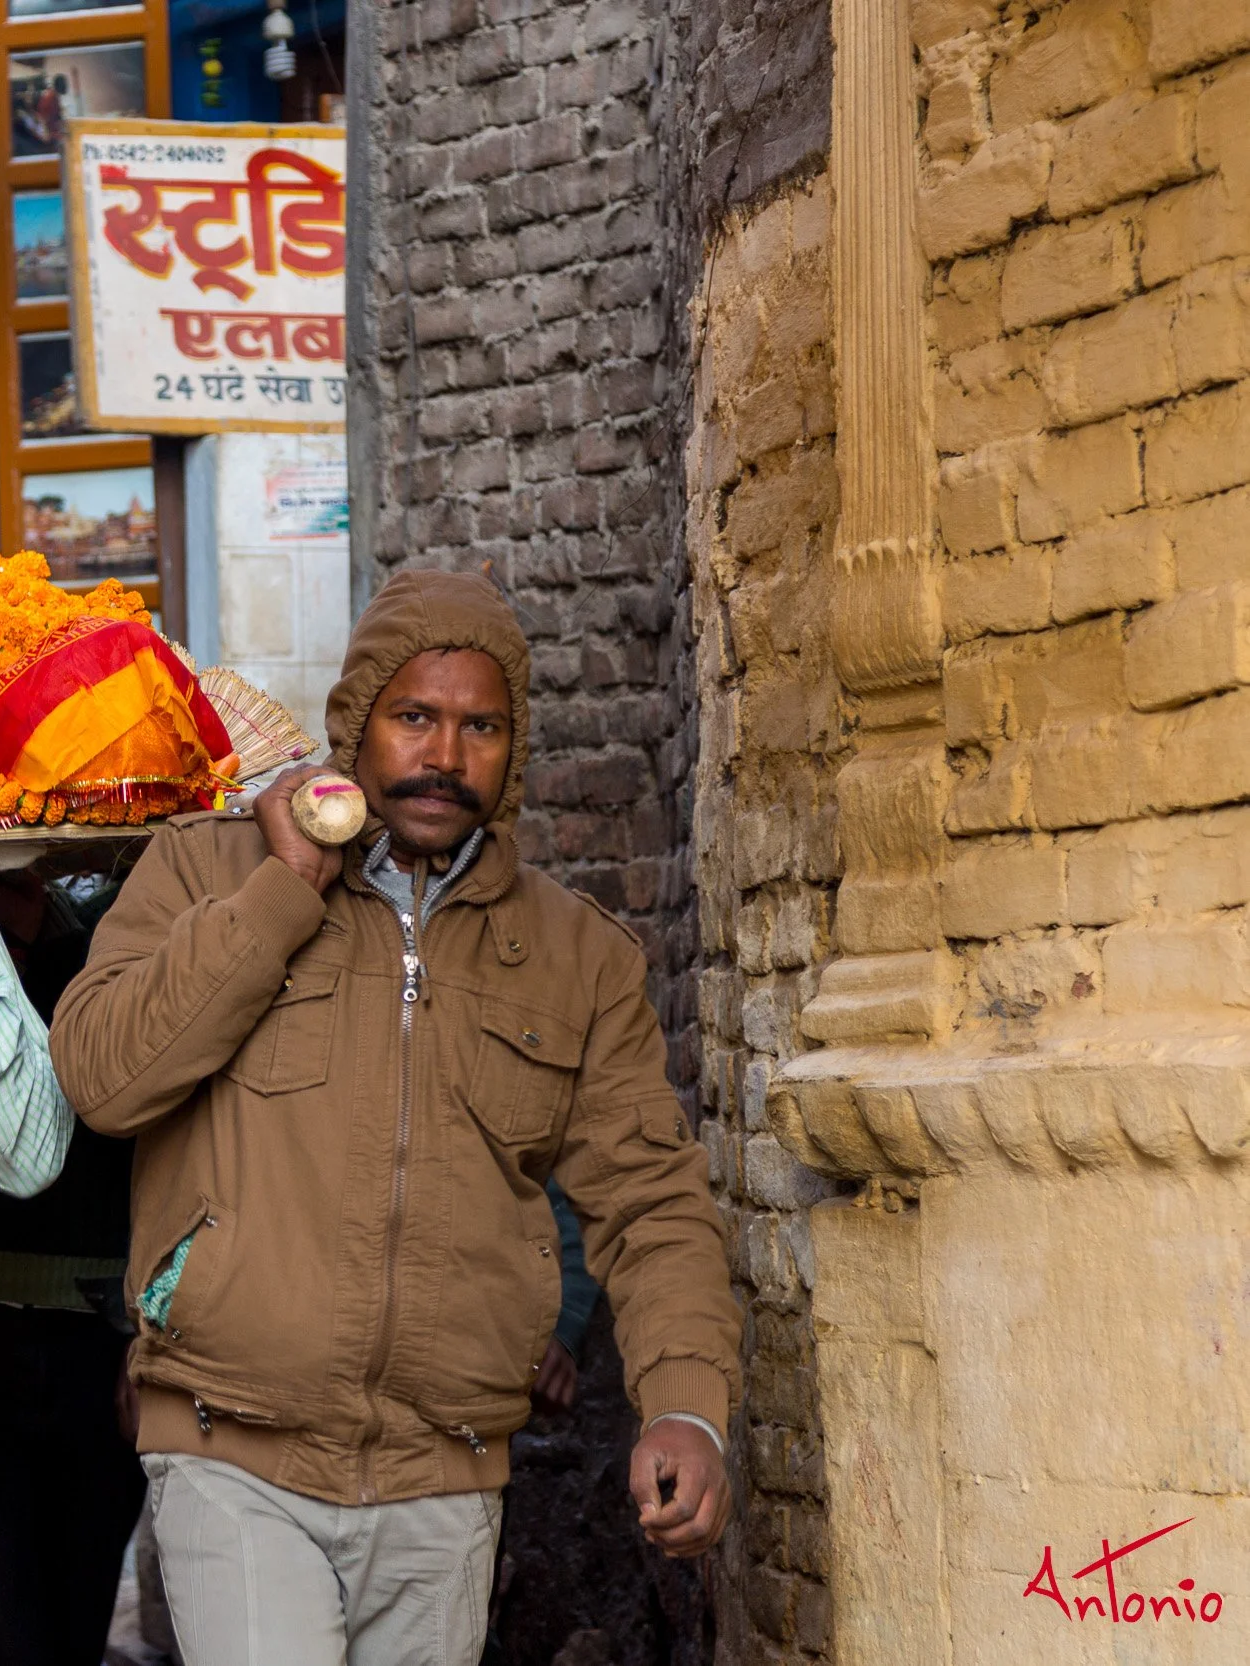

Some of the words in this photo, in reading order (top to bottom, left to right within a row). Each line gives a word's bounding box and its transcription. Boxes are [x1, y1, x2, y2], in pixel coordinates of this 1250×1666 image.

[99, 148, 346, 302] स्टूडि
[159, 307, 346, 363] एलब
[154, 374, 196, 401] 24
[255, 366, 314, 403] सेवा
